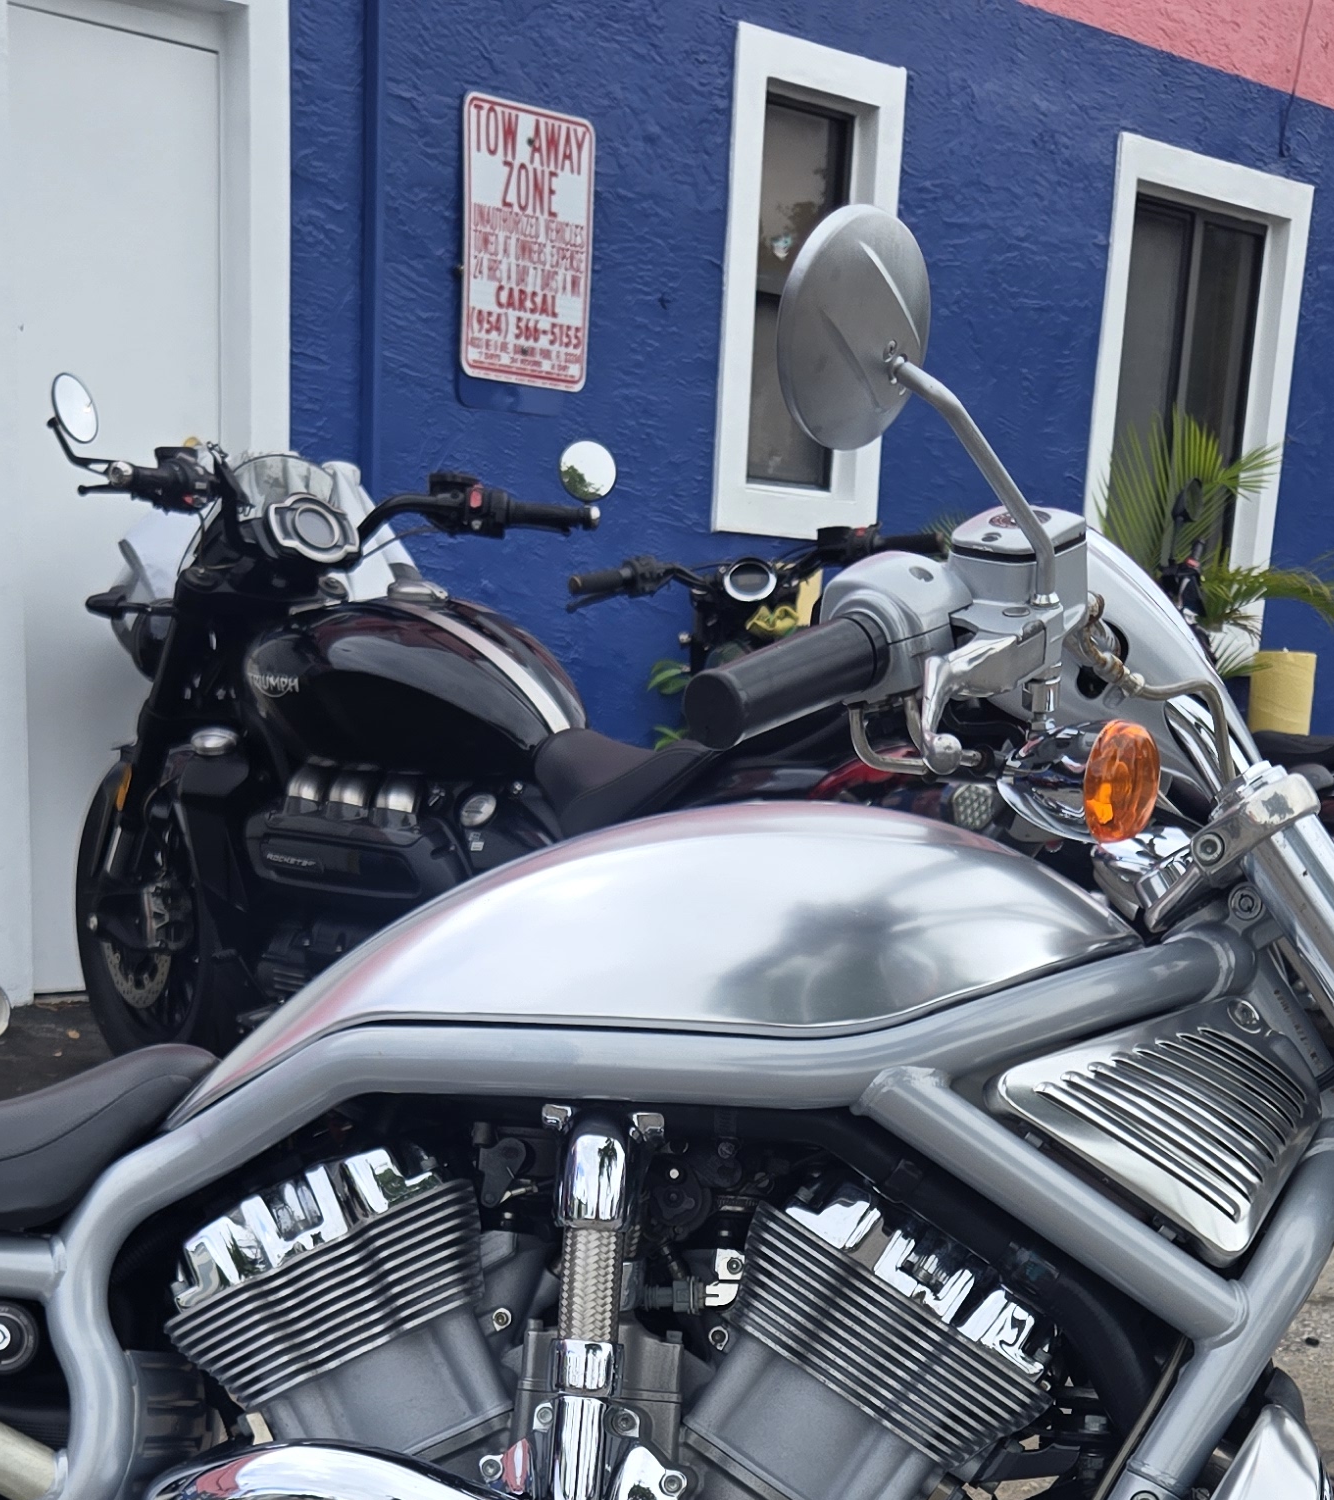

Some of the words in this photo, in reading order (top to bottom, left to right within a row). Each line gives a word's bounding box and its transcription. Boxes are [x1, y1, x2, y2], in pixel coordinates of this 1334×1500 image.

[474, 104, 519, 161] TOW
[530, 118, 587, 175] AWAY
[502, 160, 558, 218] ZONE
[495, 285, 559, 319] CARSAL
[470, 306, 509, 341] (954)
[514, 315, 583, 350] 566-5155
[247, 672, 299, 693] TRIUMPH
